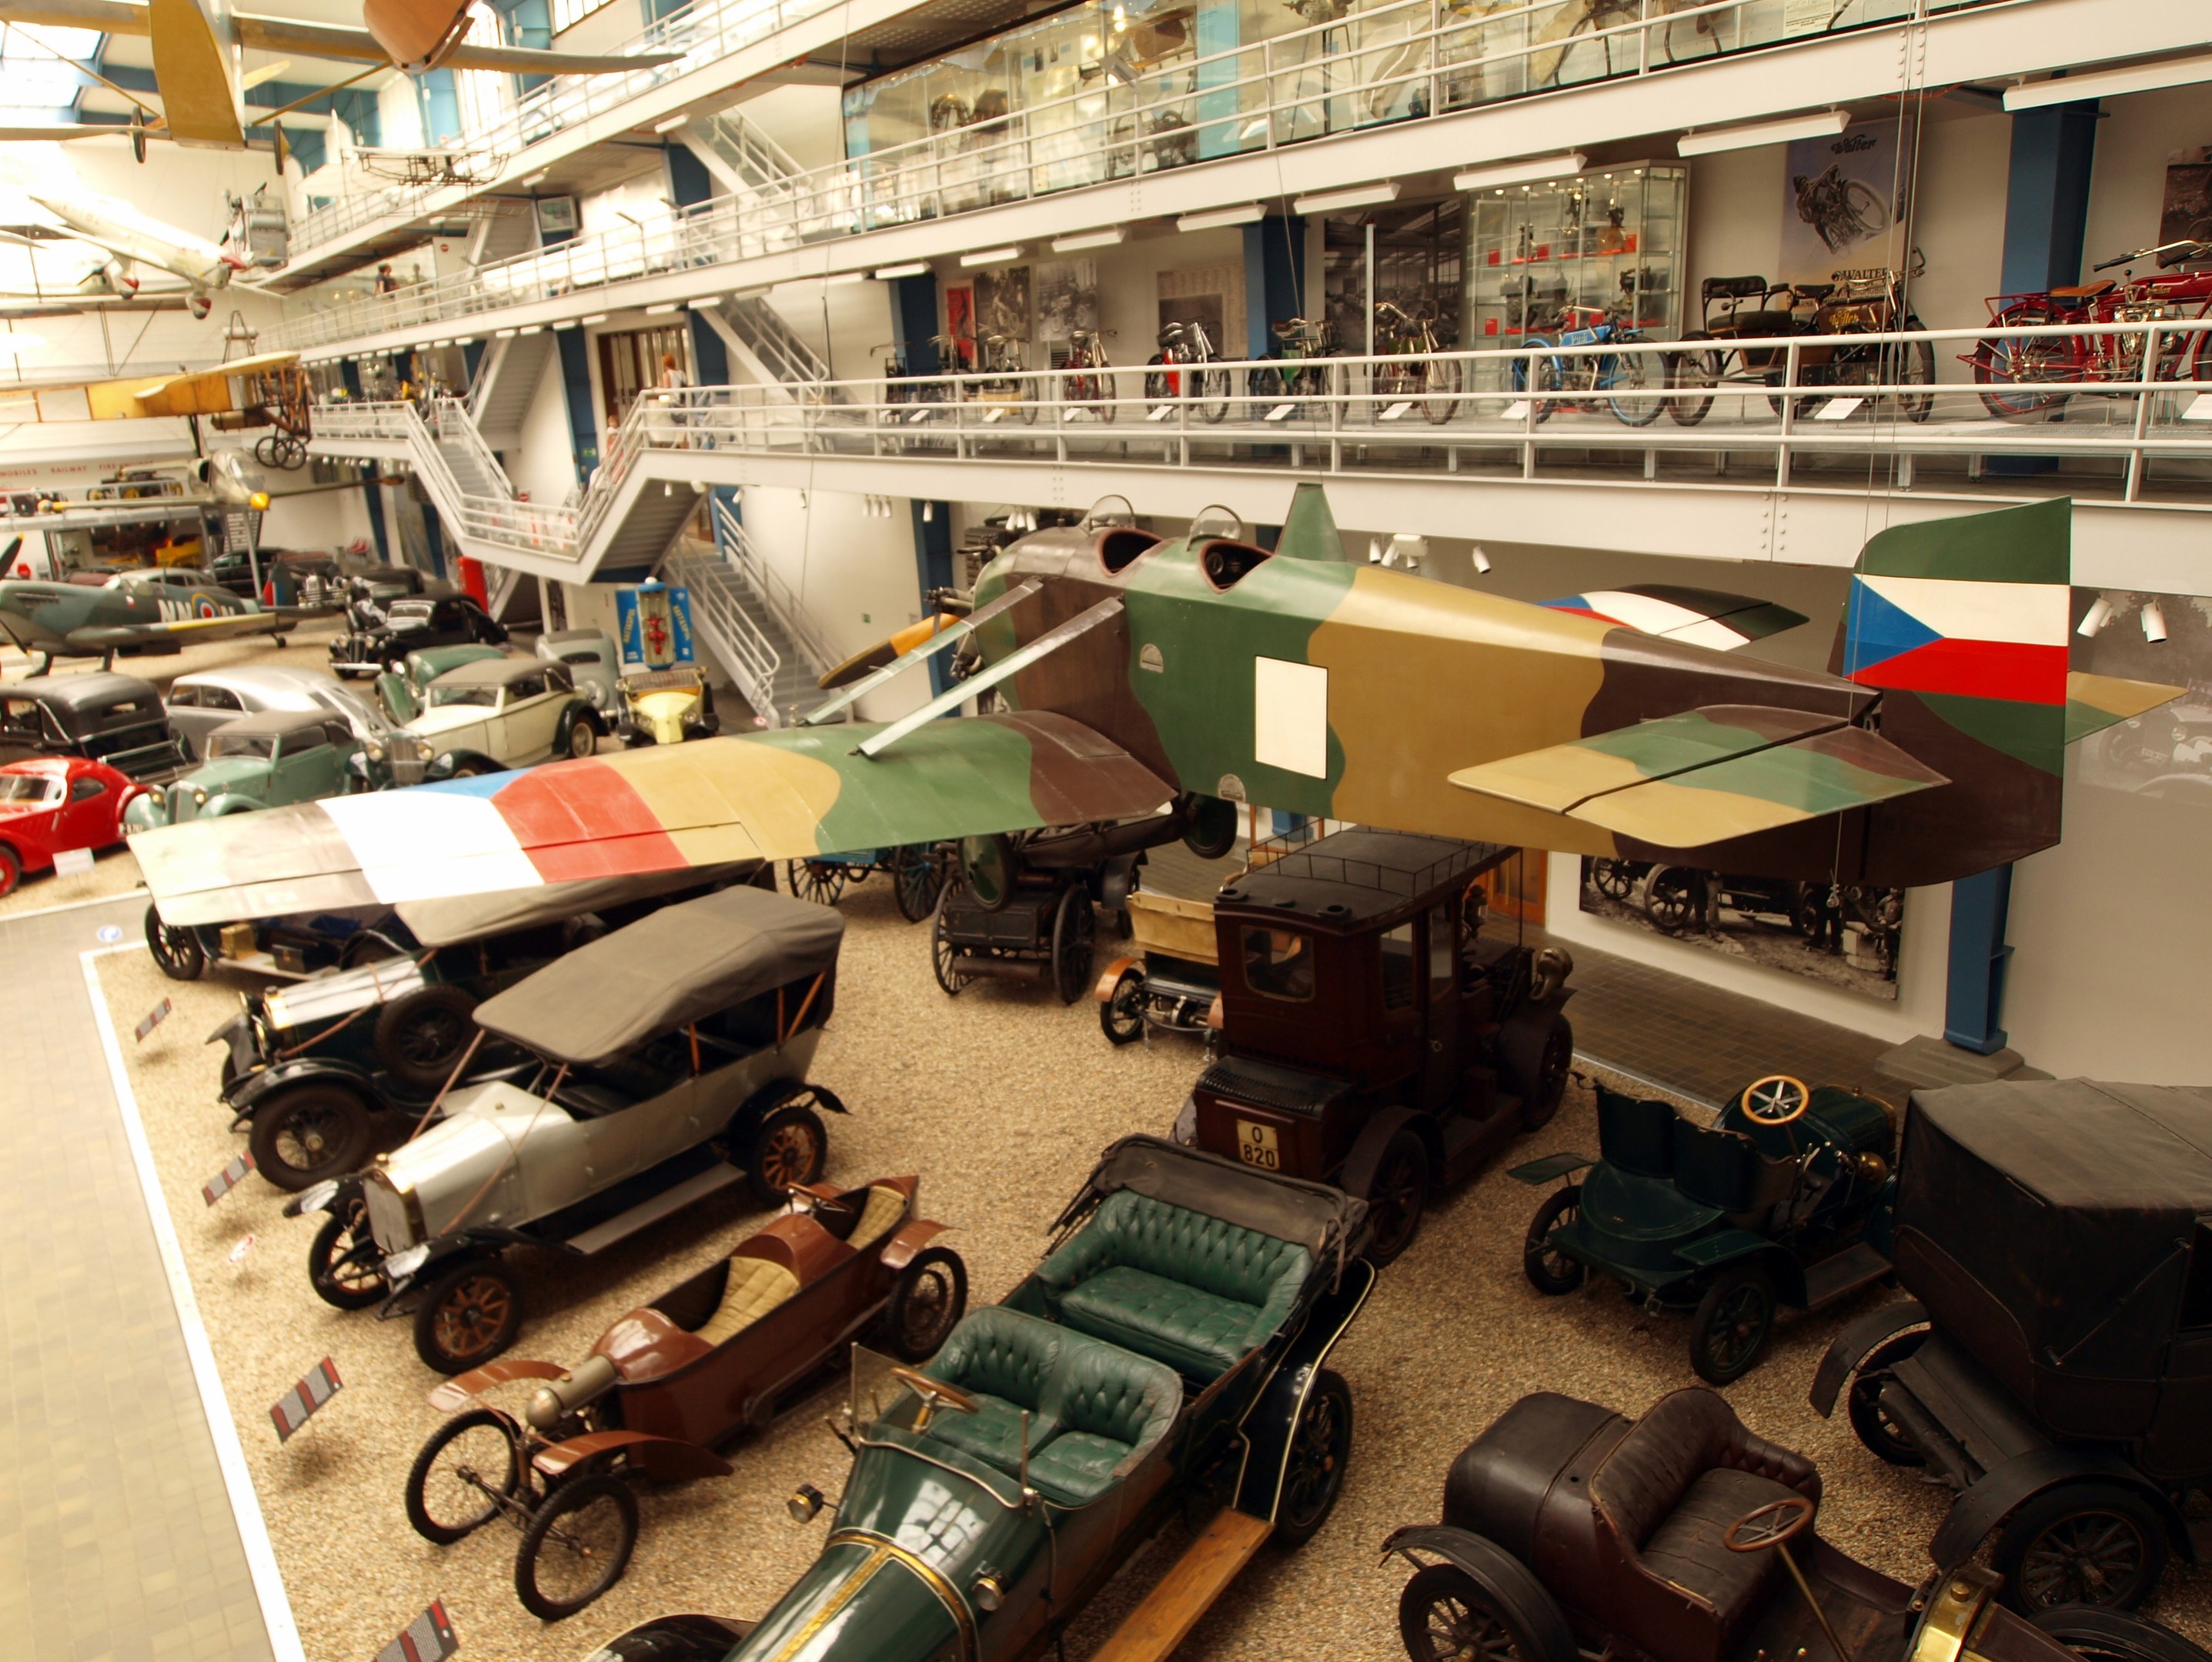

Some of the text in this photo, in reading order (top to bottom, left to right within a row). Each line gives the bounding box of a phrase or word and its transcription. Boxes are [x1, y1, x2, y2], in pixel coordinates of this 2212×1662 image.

[1831, 134, 1877, 154] Walter
[51, 466, 87, 474] RAILWAY
[158, 599, 193, 623] NN
[1244, 1144, 1275, 1167] 820
